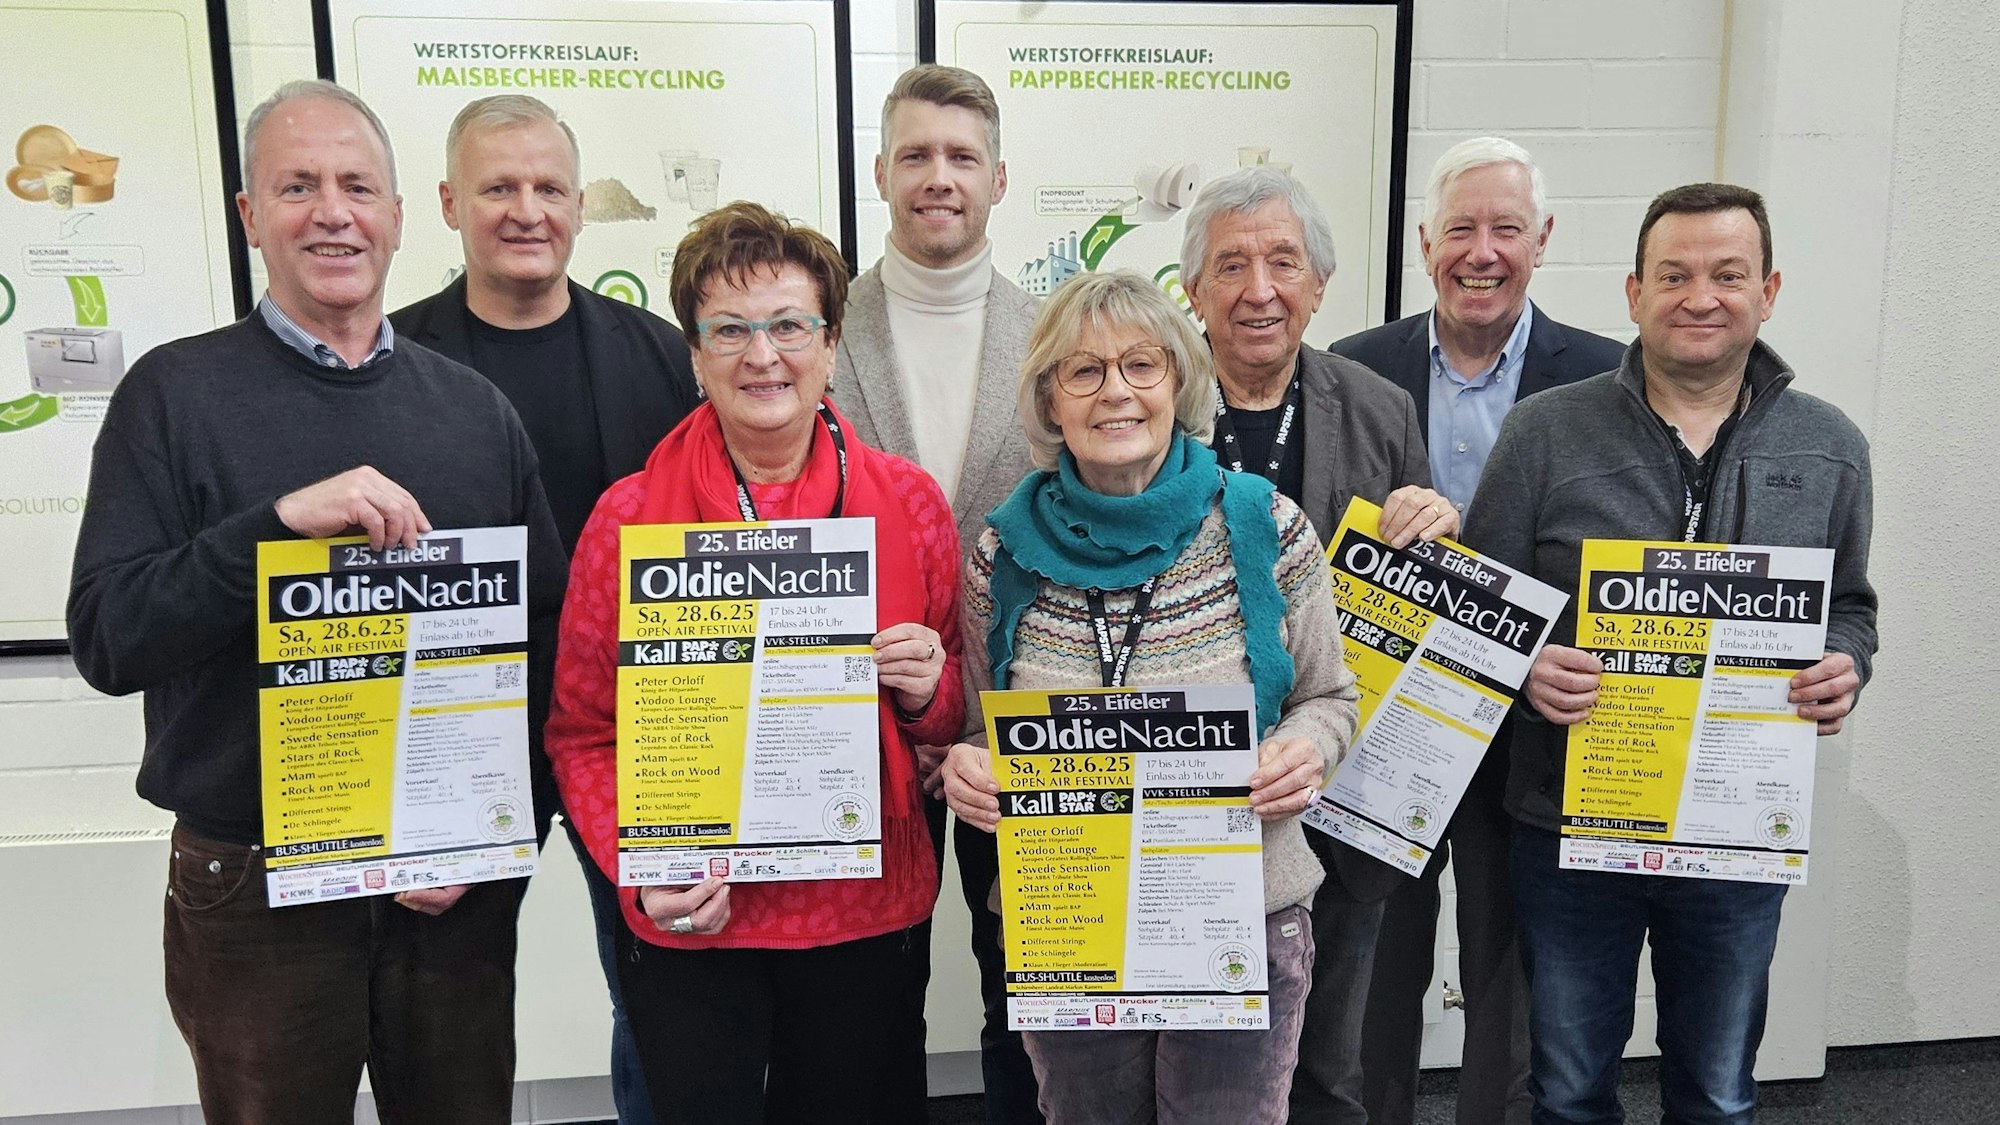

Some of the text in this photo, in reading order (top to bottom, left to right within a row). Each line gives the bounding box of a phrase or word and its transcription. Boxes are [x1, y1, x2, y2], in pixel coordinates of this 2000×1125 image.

[414, 43, 639, 61] WERTSTOFFKREISLAUF:
[1008, 48, 1213, 64] WERTSTOFFKREISLAUF:
[417, 66, 726, 90] MAISBECHER-RECYCLING
[1009, 70, 1291, 90] PAPPBECHER-RECYCLING
[1276, 404, 1296, 446] PAPSTAR
[1684, 502, 1703, 543] APSTAR
[698, 531, 798, 552] 25. Eifeler
[345, 546, 378, 567] 25.
[1408, 538, 1499, 587] 25. Eifeler
[1656, 551, 1756, 574] 25. Eifeler
[640, 557, 857, 598] OldieNacht
[281, 567, 509, 617] OldieNacht
[1345, 542, 1530, 648] OldieNacht
[1599, 577, 1810, 620] OldieNacht
[637, 604, 754, 626] Sa, 28.6.25
[1361, 587, 1431, 628] 28.6.25
[636, 624, 754, 636] OPEN AIR FESTIVAL
[1354, 603, 1374, 618] AIR
[1375, 612, 1421, 641] FESTIVAL
[1593, 616, 1708, 638] Sa, 28.6.25
[279, 618, 404, 646] Sa, 28.6.25
[1095, 618, 1114, 663] PAPSTAR
[1349, 626, 1381, 647] STAR
[279, 638, 405, 657] OPEN AIR FESTIVAL
[765, 637, 828, 645] VVK-STELLEN
[1449, 629, 1461, 643] bis
[1461, 635, 1472, 646] 24
[1473, 641, 1489, 655] Uhr
[1592, 635, 1707, 651] OPEN AIR FESTIVAL
[416, 647, 480, 659] VVK-STELLEN
[634, 641, 677, 663] Kall
[681, 651, 716, 661] STAR
[1432, 636, 1497, 671] Einlass ab 16 Uhr
[1112, 646, 1132, 688] APSTAR
[1423, 649, 1478, 680] VVK-STELLEN
[1634, 662, 1667, 674] STAR
[1715, 656, 1778, 667] VVK-STELLEN
[277, 659, 323, 685] Kall
[329, 667, 365, 680] STAR
[641, 675, 704, 686] Peter Orloff
[641, 694, 716, 706] Vodoo Lounge
[1064, 693, 1171, 711] 25. Eifeler
[640, 712, 728, 724] Swede Sensation
[640, 732, 711, 743] Stars of Rock
[1008, 715, 1237, 751] OldieNacht
[286, 746, 360, 763] Stars of Rock
[641, 754, 667, 763] Mam
[1147, 758, 1206, 768] 17 bis 24 Uhr
[641, 766, 720, 777] Rock on Wood
[1009, 756, 1130, 777] Sa, 28.6.25
[1010, 775, 1132, 787] OPEN AIR FESTIVAL
[1146, 770, 1224, 781] Einlass ab 16 Uhr
[1143, 788, 1210, 797] VVK-STELLEN
[1010, 792, 1054, 814] Kall
[1058, 802, 1094, 812] STAR
[627, 825, 696, 837] BUS-SHUTTLE
[1019, 825, 1084, 836] Peter Orloff
[1571, 816, 1635, 829] BUS-SHUTTLE
[276, 839, 347, 856] BUS-SHUTTLE
[1021, 844, 1097, 856] Vodoo Lounge
[1022, 862, 1110, 873] Swede Sensation
[1023, 881, 1093, 892] Stars of Rock
[1025, 902, 1051, 911] Mam
[1025, 915, 1051, 924] Rock
[1072, 914, 1104, 923] Wood
[1040, 949, 1076, 957] Schlingele
[1014, 972, 1116, 982] BUS-SHUTTLE kostenlos!
